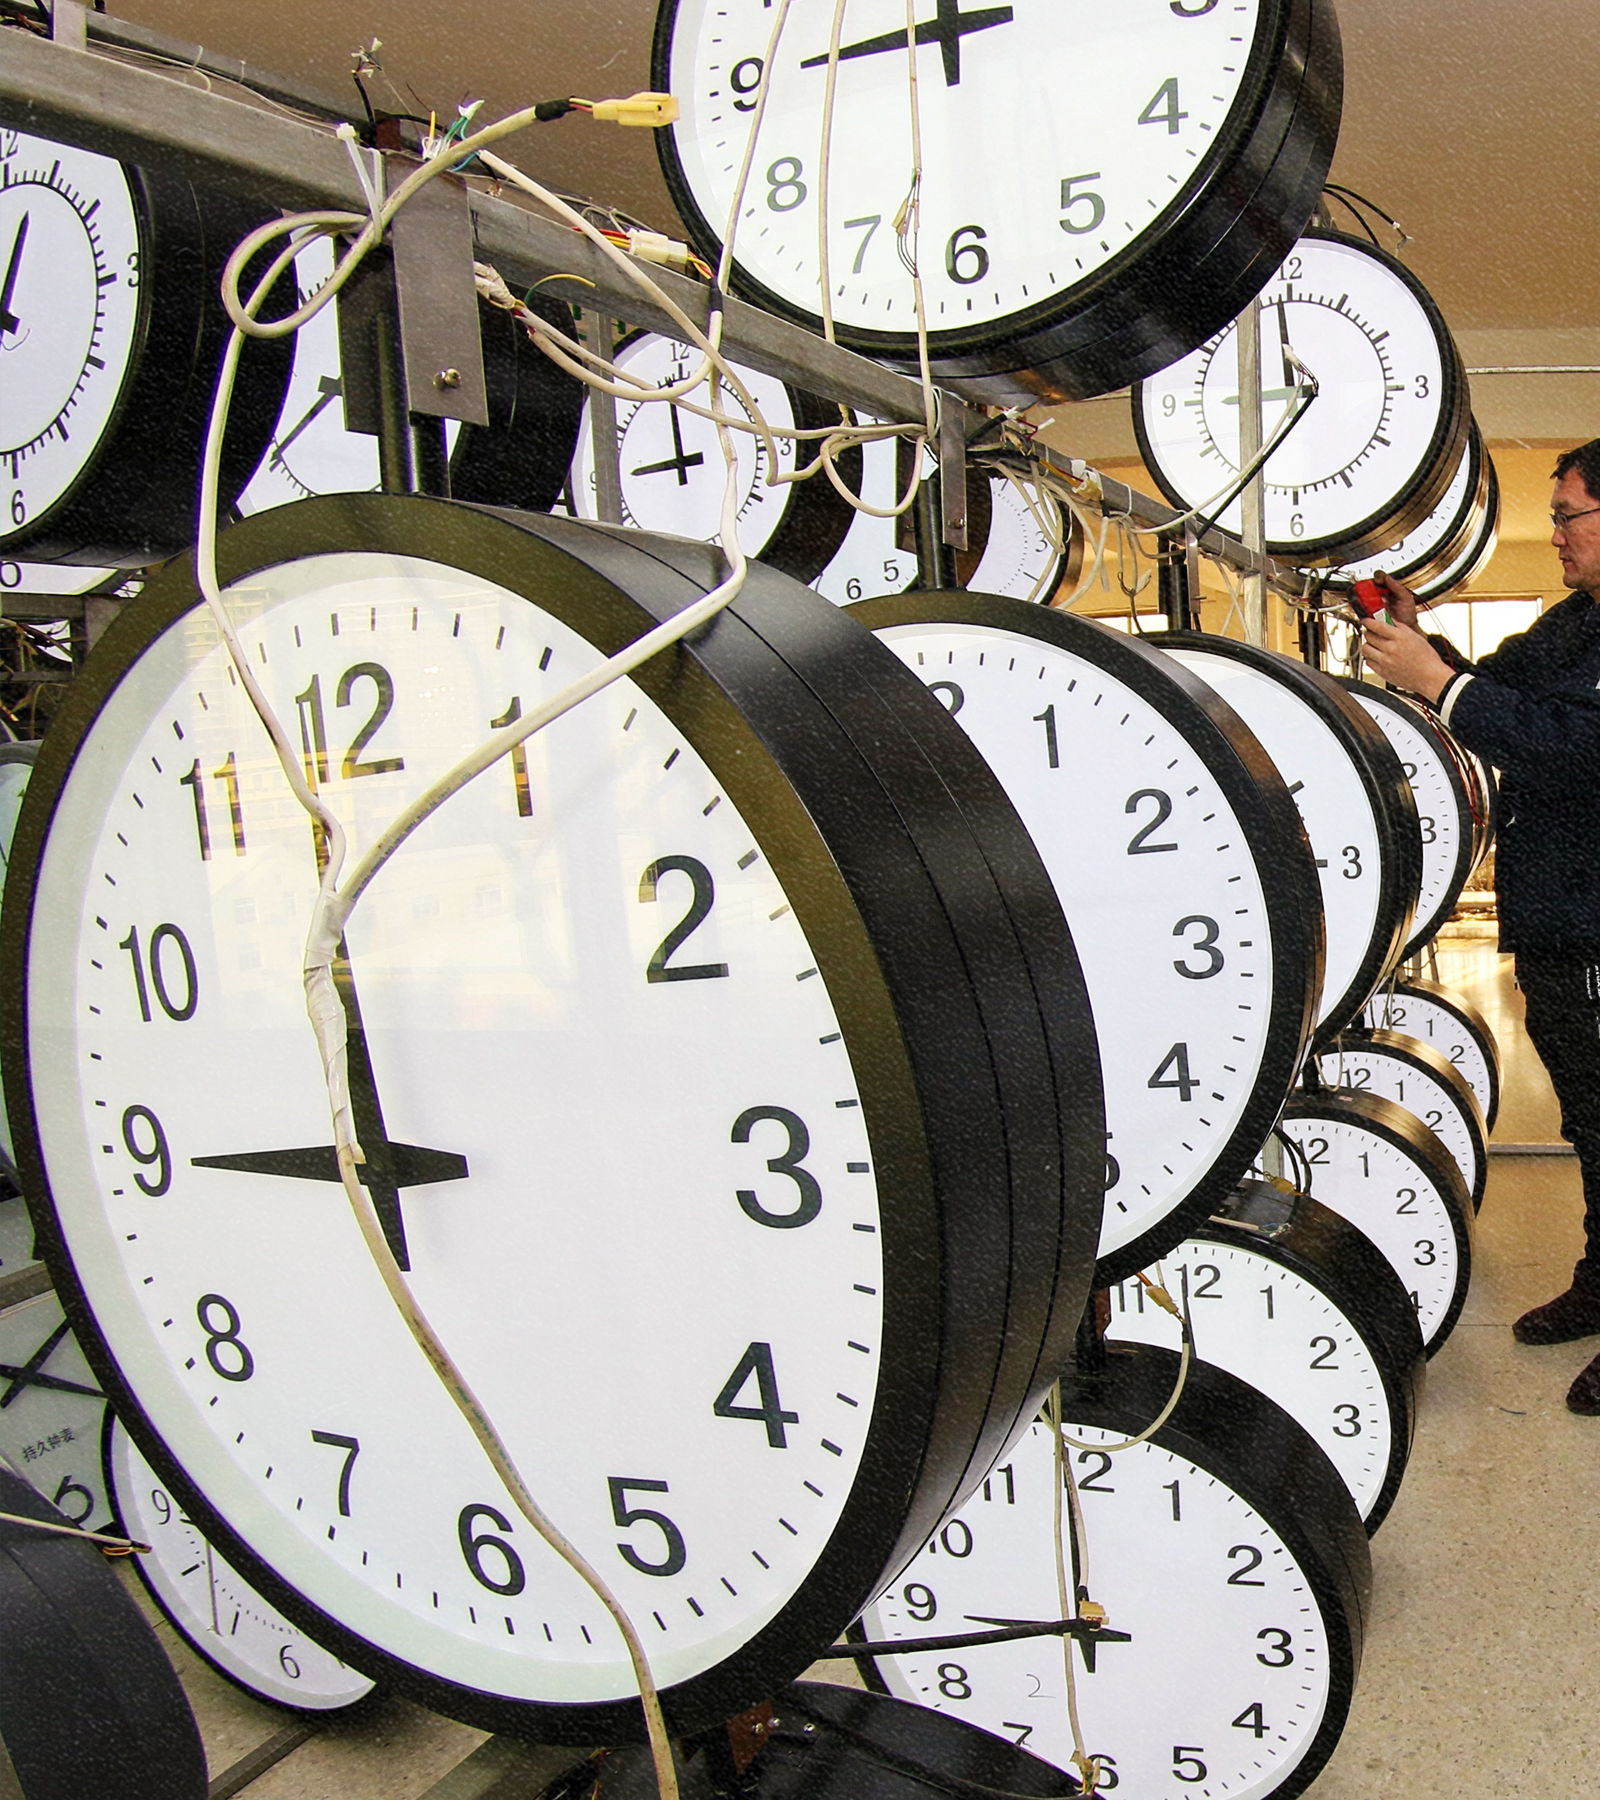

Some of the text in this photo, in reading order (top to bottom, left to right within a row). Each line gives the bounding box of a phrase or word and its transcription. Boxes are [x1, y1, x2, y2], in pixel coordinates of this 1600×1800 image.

[731, 57, 766, 111] 9
[1138, 77, 1188, 135] 4
[766, 157, 807, 212] 8
[1059, 172, 1105, 235] 5
[844, 214, 881, 274] 7
[945, 225, 989, 285] 6
[128, 252, 139, 287] 3
[1277, 258, 1302, 280] 12
[670, 342, 690, 362] 12
[1162, 394, 1176, 417] 9
[1415, 375, 1429, 399] 3
[780, 437, 791, 456] 3
[11, 489, 25, 525] 6
[1290, 513, 1304, 537] 6
[1035, 533, 1048, 553] 3
[846, 578, 862, 600] 6
[884, 559, 899, 582] 5
[295, 661, 406, 784] 12
[1033, 704, 1059, 769] 1
[490, 696, 535, 818] 1
[180, 751, 246, 861] 11
[1125, 789, 1178, 855] 2
[1342, 846, 1362, 879] 3
[639, 855, 729, 984] 2
[1172, 915, 1224, 980] 3
[119, 923, 198, 1022] 10
[1426, 1019, 1433, 1037] 1
[1148, 1042, 1200, 1102] 4
[1451, 1045, 1465, 1063] 2
[1344, 1068, 1372, 1090] 12
[1396, 1080, 1405, 1101] 1
[1426, 1110, 1444, 1132] 2
[122, 1105, 172, 1197] 9
[731, 1105, 822, 1229] 3
[1358, 1151, 1369, 1178] 1
[1396, 1188, 1418, 1215] 2
[1414, 1240, 1436, 1266] 3
[1174, 1264, 1223, 1299] 12
[1260, 1285, 1274, 1319] 1
[197, 1294, 254, 1382] 8
[1310, 1336, 1339, 1370] 2
[713, 1342, 799, 1449] 4
[1332, 1404, 1361, 1437] 3
[311, 1430, 360, 1517] 7
[983, 1463, 1015, 1505] 11
[151, 1489, 171, 1525] 9
[1163, 1480, 1180, 1521] 1
[607, 1476, 686, 1577] 5
[458, 1503, 525, 1596] 6
[1227, 1545, 1265, 1587] 2
[903, 1583, 937, 1621] 9
[279, 1645, 301, 1679] 6
[1256, 1628, 1294, 1667] 3
[937, 1663, 972, 1700] 8
[1232, 1702, 1270, 1738] 4
[1092, 1753, 1120, 1790] 6
[1172, 1746, 1207, 1782] 5
